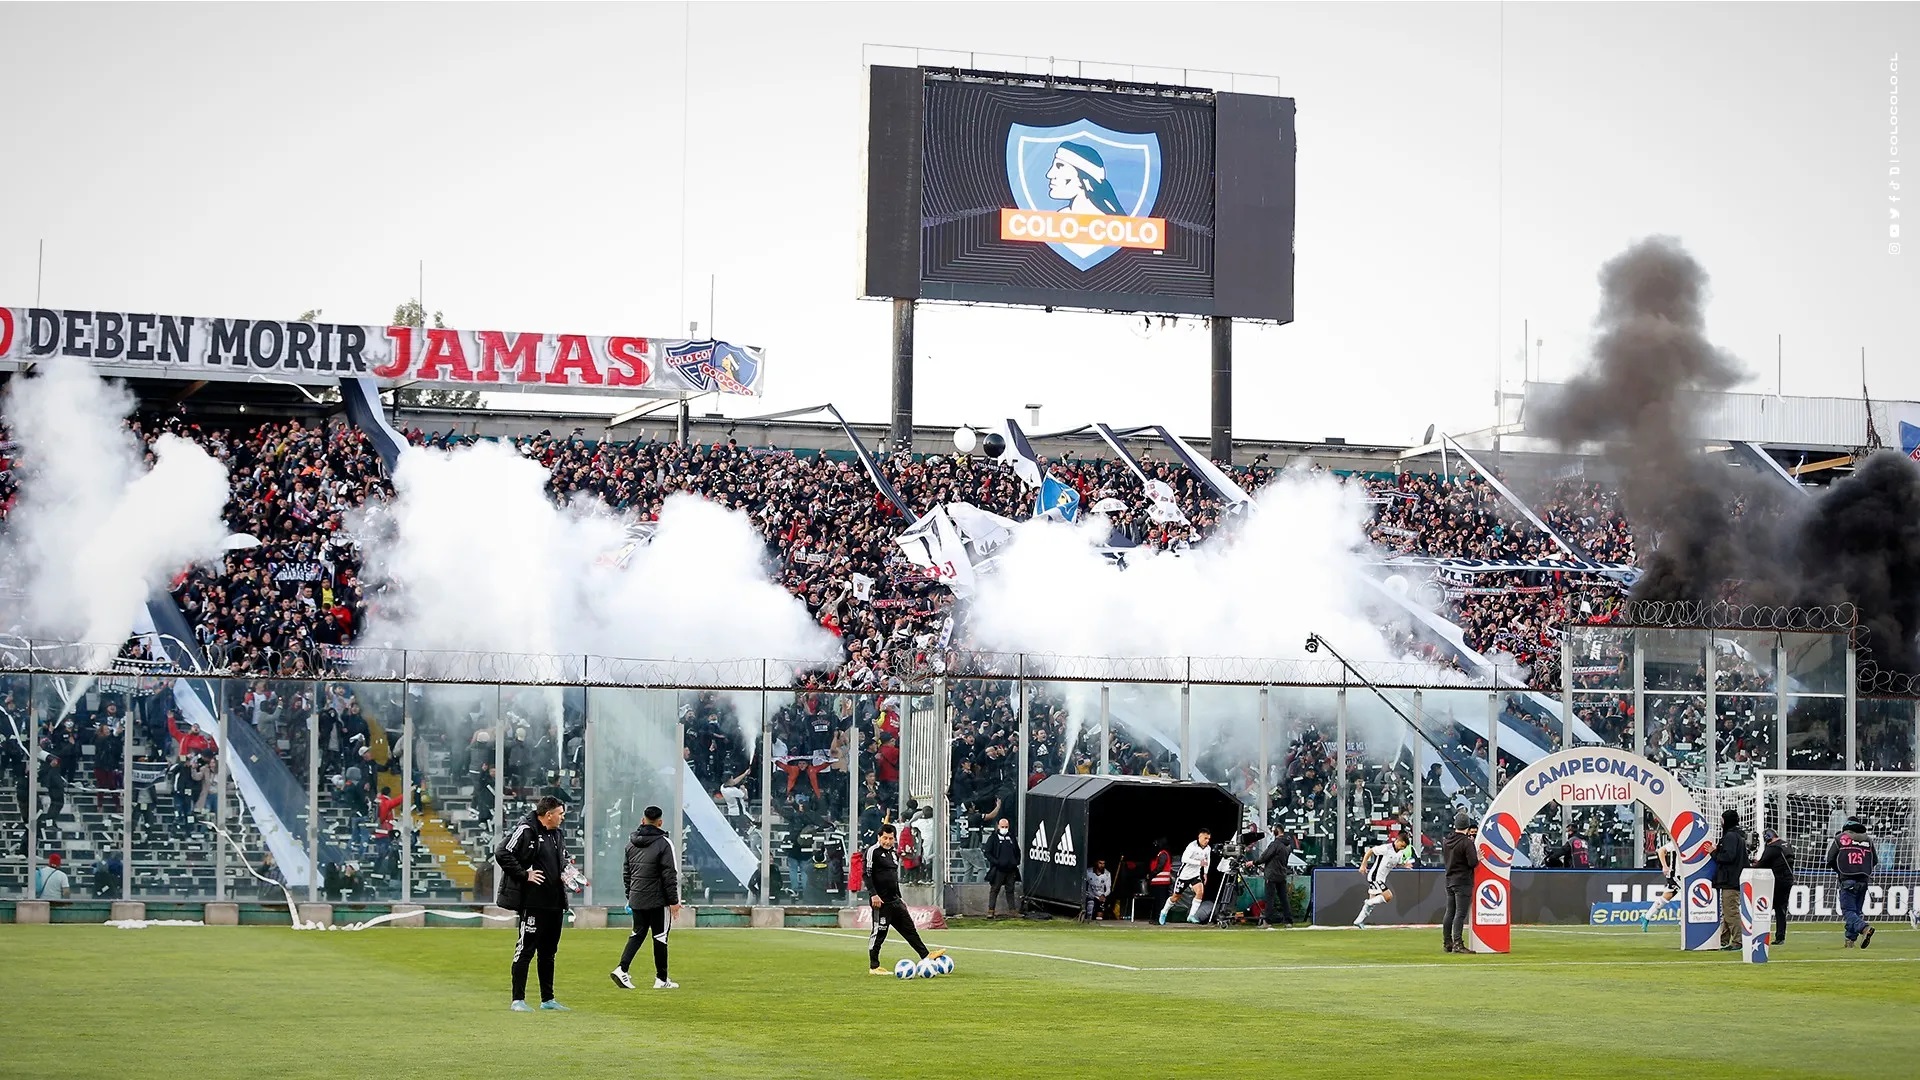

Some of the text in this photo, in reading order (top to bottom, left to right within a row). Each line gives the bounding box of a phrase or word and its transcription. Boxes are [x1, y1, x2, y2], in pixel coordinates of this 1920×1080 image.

[1008, 213, 1159, 244] COLO-COLO
[28, 308, 194, 362] DEBEN
[207, 317, 367, 373] MORIR
[373, 326, 653, 387] JAMAS
[668, 355, 694, 366] COLO
[702, 365, 752, 396] COLO-COLO
[1524, 757, 1665, 796] CAMPEONATO
[1560, 783, 1631, 801] PlanVital
[1029, 846, 1051, 863] adidas
[1054, 850, 1077, 867] adidas
[1847, 852, 1863, 865] 125
